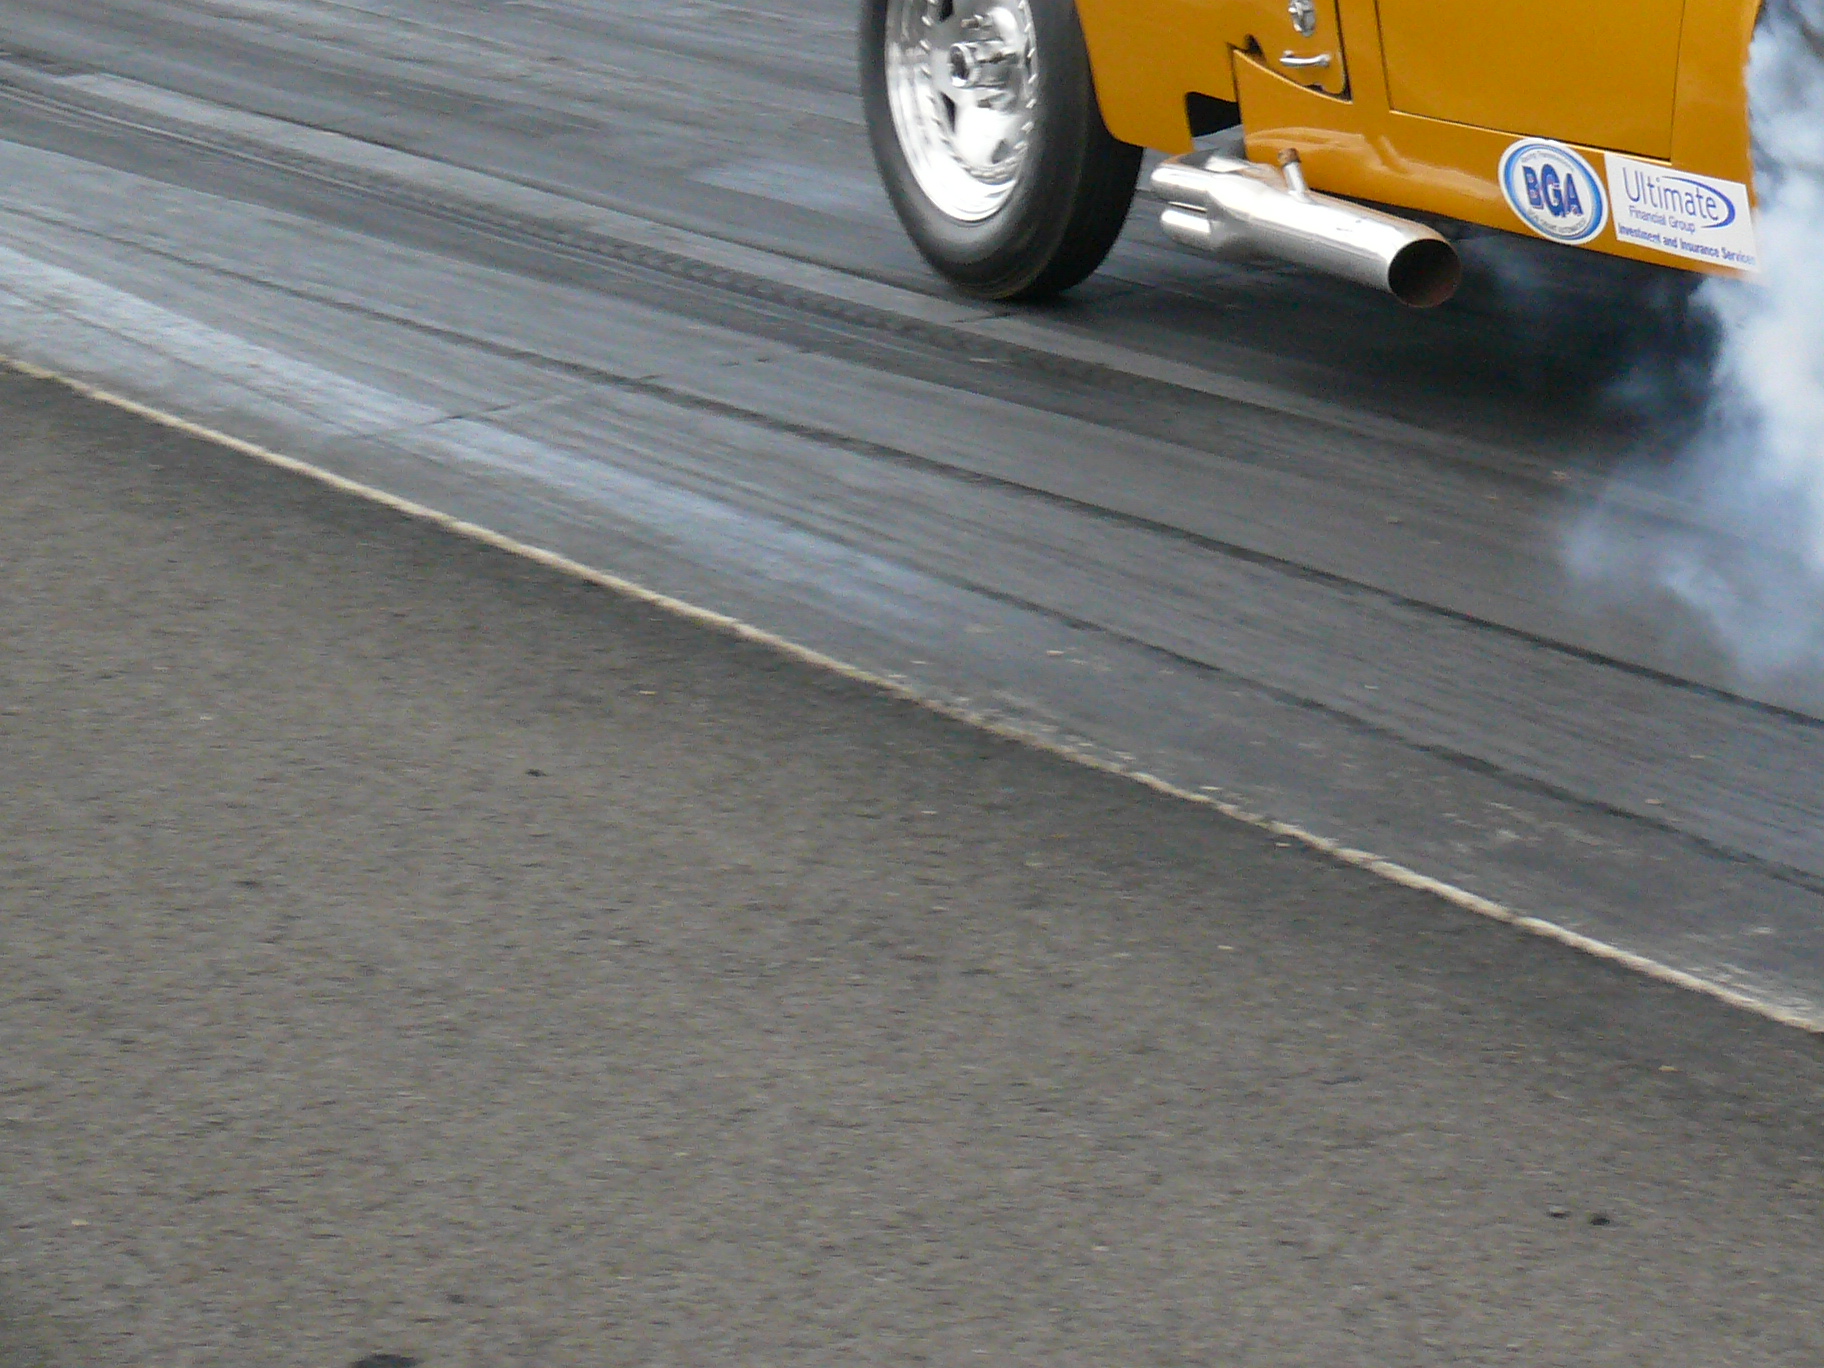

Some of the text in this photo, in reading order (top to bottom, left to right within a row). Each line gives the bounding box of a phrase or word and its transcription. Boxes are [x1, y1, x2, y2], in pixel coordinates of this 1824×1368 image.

[1522, 163, 1584, 218] BGA
[1622, 167, 1719, 221] Ultimate
[1628, 205, 1696, 235] Financial Group
[1618, 223, 1757, 266] Investment and Insurance Services
